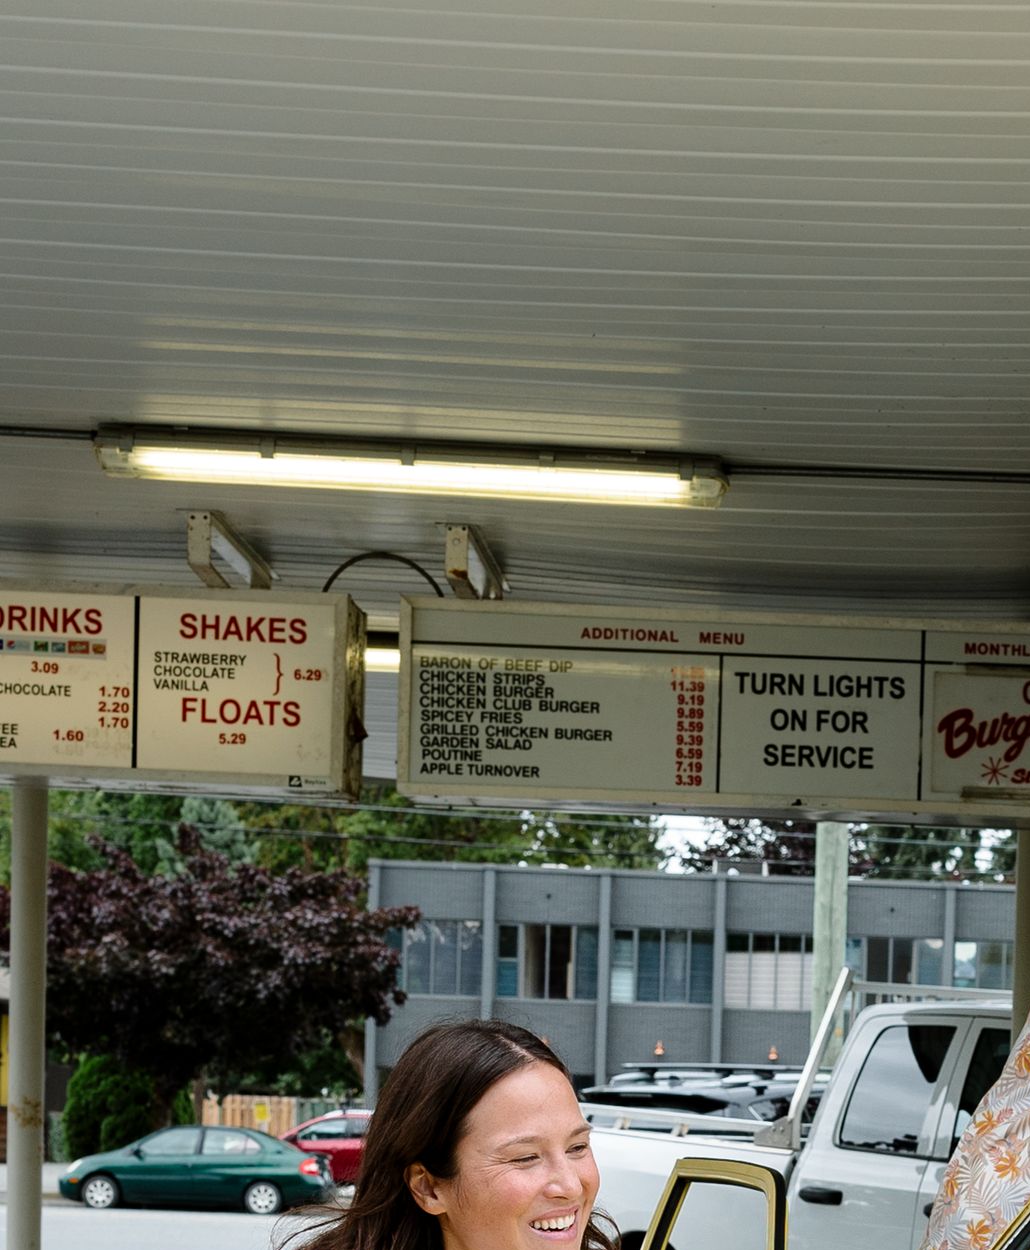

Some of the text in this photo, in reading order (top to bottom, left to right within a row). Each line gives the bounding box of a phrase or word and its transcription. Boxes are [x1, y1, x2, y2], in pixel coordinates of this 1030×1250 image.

[0, 605, 103, 634] RINKS
[179, 613, 307, 644] SHAKES
[581, 627, 745, 645] ADDITIONAL MENU
[31, 661, 59, 674] 3.09
[154, 651, 246, 666] STRAWBERRY
[420, 656, 573, 673] BARON OF BEEF DIP
[154, 665, 322, 682] CHOCOLATE 6.29
[154, 678, 209, 692] VANILLA
[420, 670, 705, 692] CHICKEN STRIPS 11.39
[99, 686, 130, 698] 1.70
[420, 683, 704, 706] CHICKEN BURGER 9.19
[734, 671, 805, 696] TURN
[813, 674, 906, 700] LIGHTS
[98, 701, 129, 713] 2.20
[181, 697, 301, 727] FLOATS
[420, 696, 704, 720] CHICKEN CLUB BURGER 9.89
[98, 717, 129, 729] 1.70
[421, 709, 704, 733] SPICEY FRIES 5.59
[770, 708, 869, 734] ON FOR
[53, 729, 84, 742] 1.60
[219, 732, 246, 745] 5.29
[420, 723, 703, 746] GRILLED CHICKEN BURGER 9.39
[420, 736, 703, 760] GARDEN SALAD 6.59
[763, 744, 874, 769] SERVICE
[422, 749, 703, 773] POUTINE 7.19
[420, 763, 702, 787] APPLE TURNOVER 3.39
